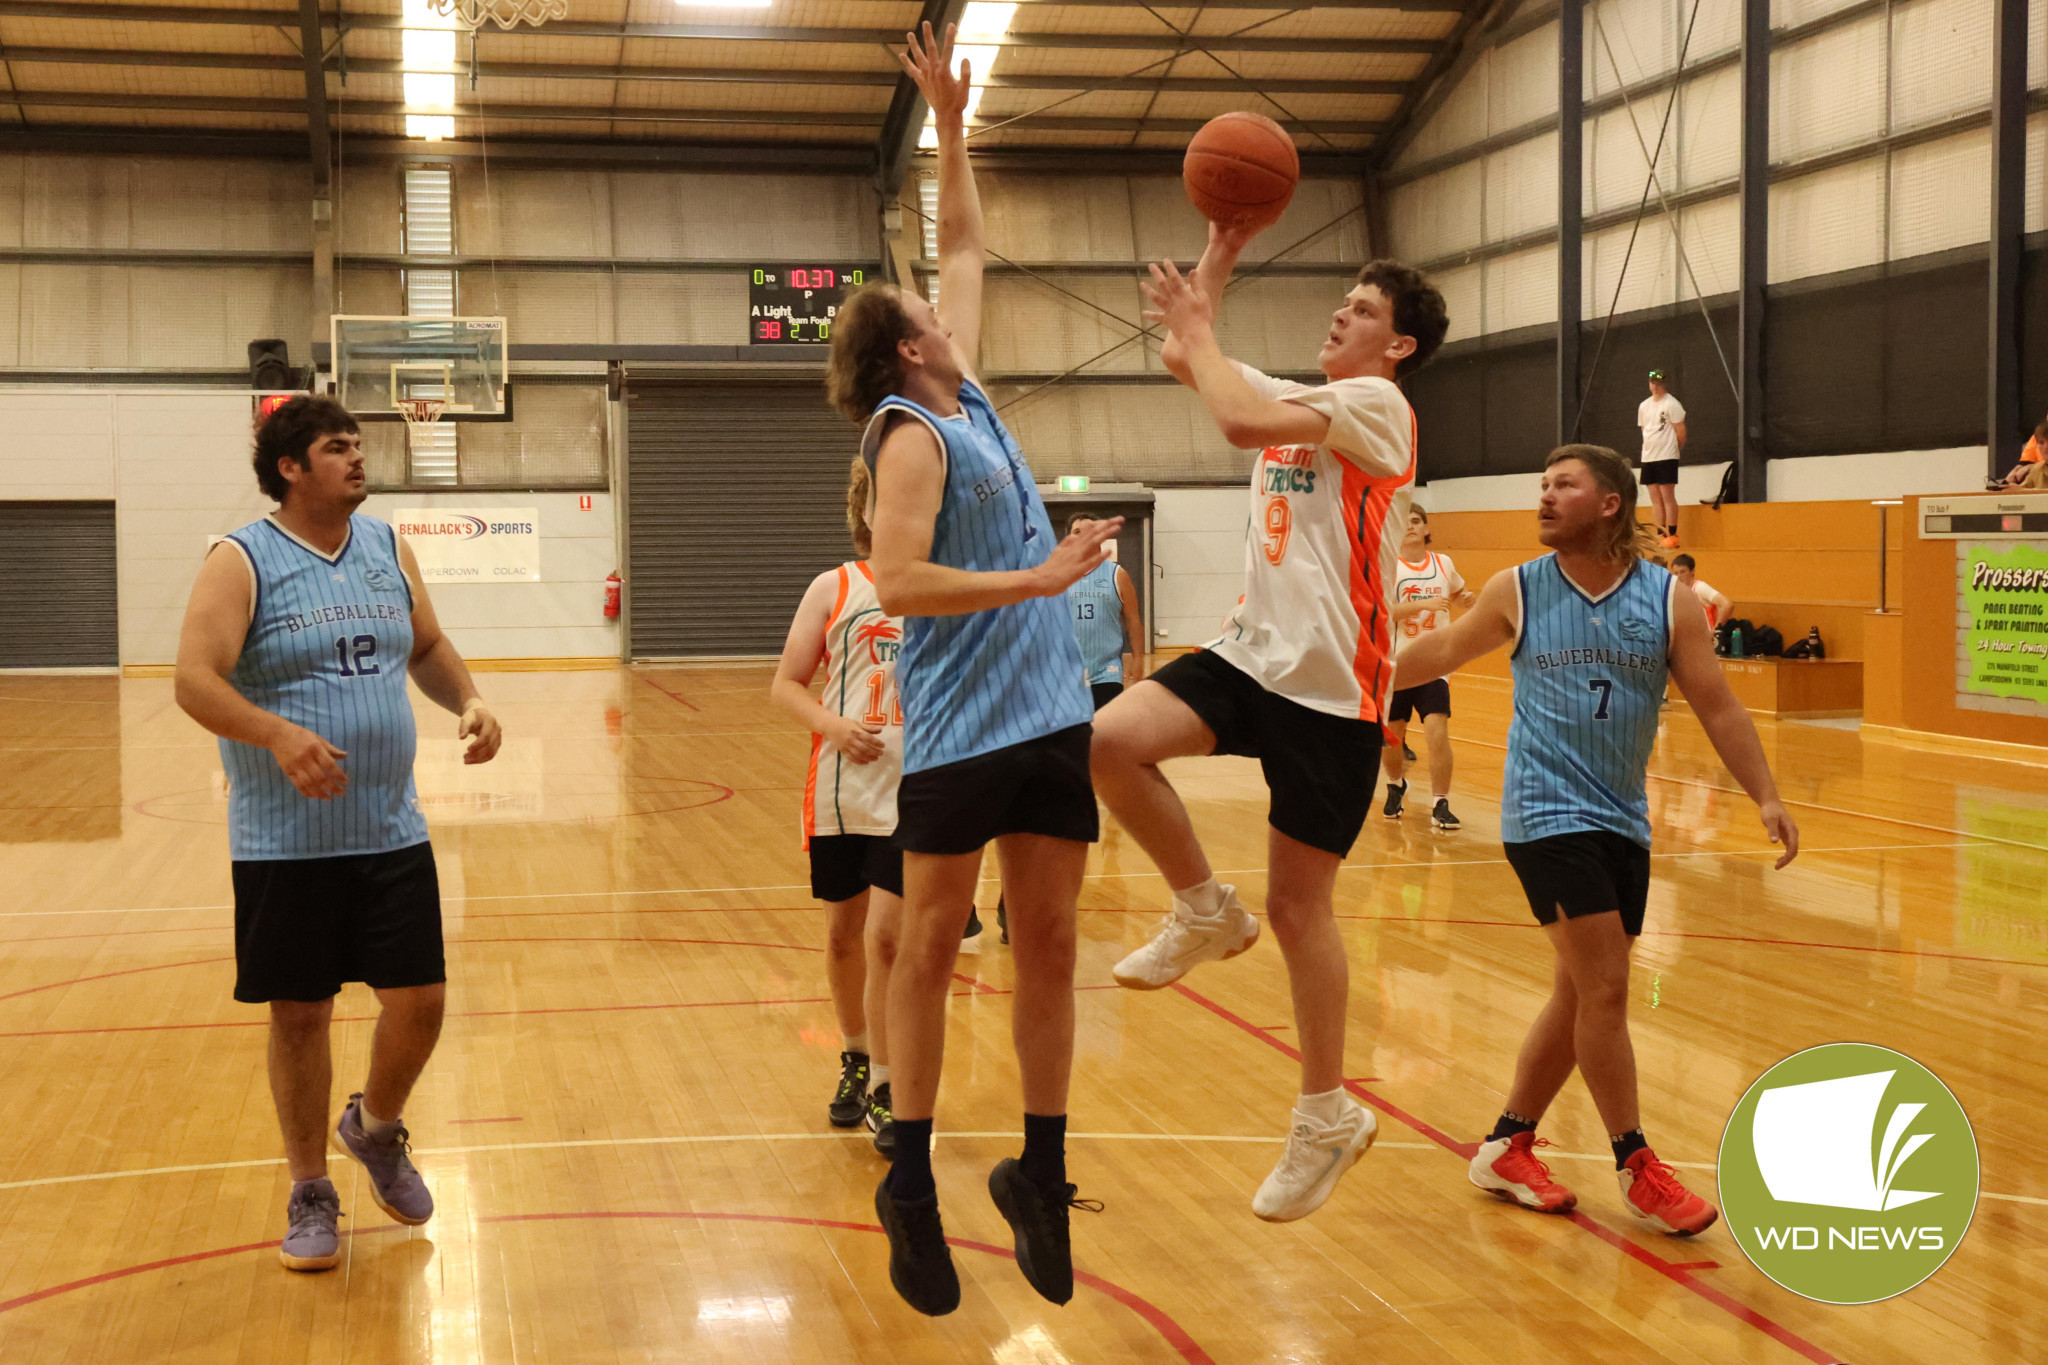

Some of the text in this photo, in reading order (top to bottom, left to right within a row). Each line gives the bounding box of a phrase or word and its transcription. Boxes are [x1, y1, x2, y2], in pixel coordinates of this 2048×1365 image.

[754, 269, 764, 285] 0
[765, 275, 776, 283] TO
[842, 275, 853, 284] TO
[853, 270, 863, 286] 0
[804, 290, 814, 299] P
[752, 305, 792, 319] A Light
[827, 306, 836, 317] B
[787, 316, 832, 325] Team Fouls
[760, 321, 782, 339] 38
[790, 323, 800, 339] 2
[819, 323, 829, 339] 0
[399, 523, 532, 536] BENALLACK'S SPORTS
[1264, 495, 1292, 566] 9
[422, 567, 527, 576] MPERDOWN COLAC
[1972, 560, 2048, 593] Prossers
[1070, 592, 1111, 601] UEBALLERS
[1077, 603, 1095, 620] 13
[2008, 604, 2044, 616] BEATING
[285, 604, 404, 634] BLUEBALLERS
[1984, 620, 2009, 631] SPRAY
[334, 633, 381, 679] 12
[1977, 639, 2048, 660] 24 Hour Towing
[1536, 648, 1658, 674] BLUEBALLERS
[1588, 679, 1613, 720] 7
